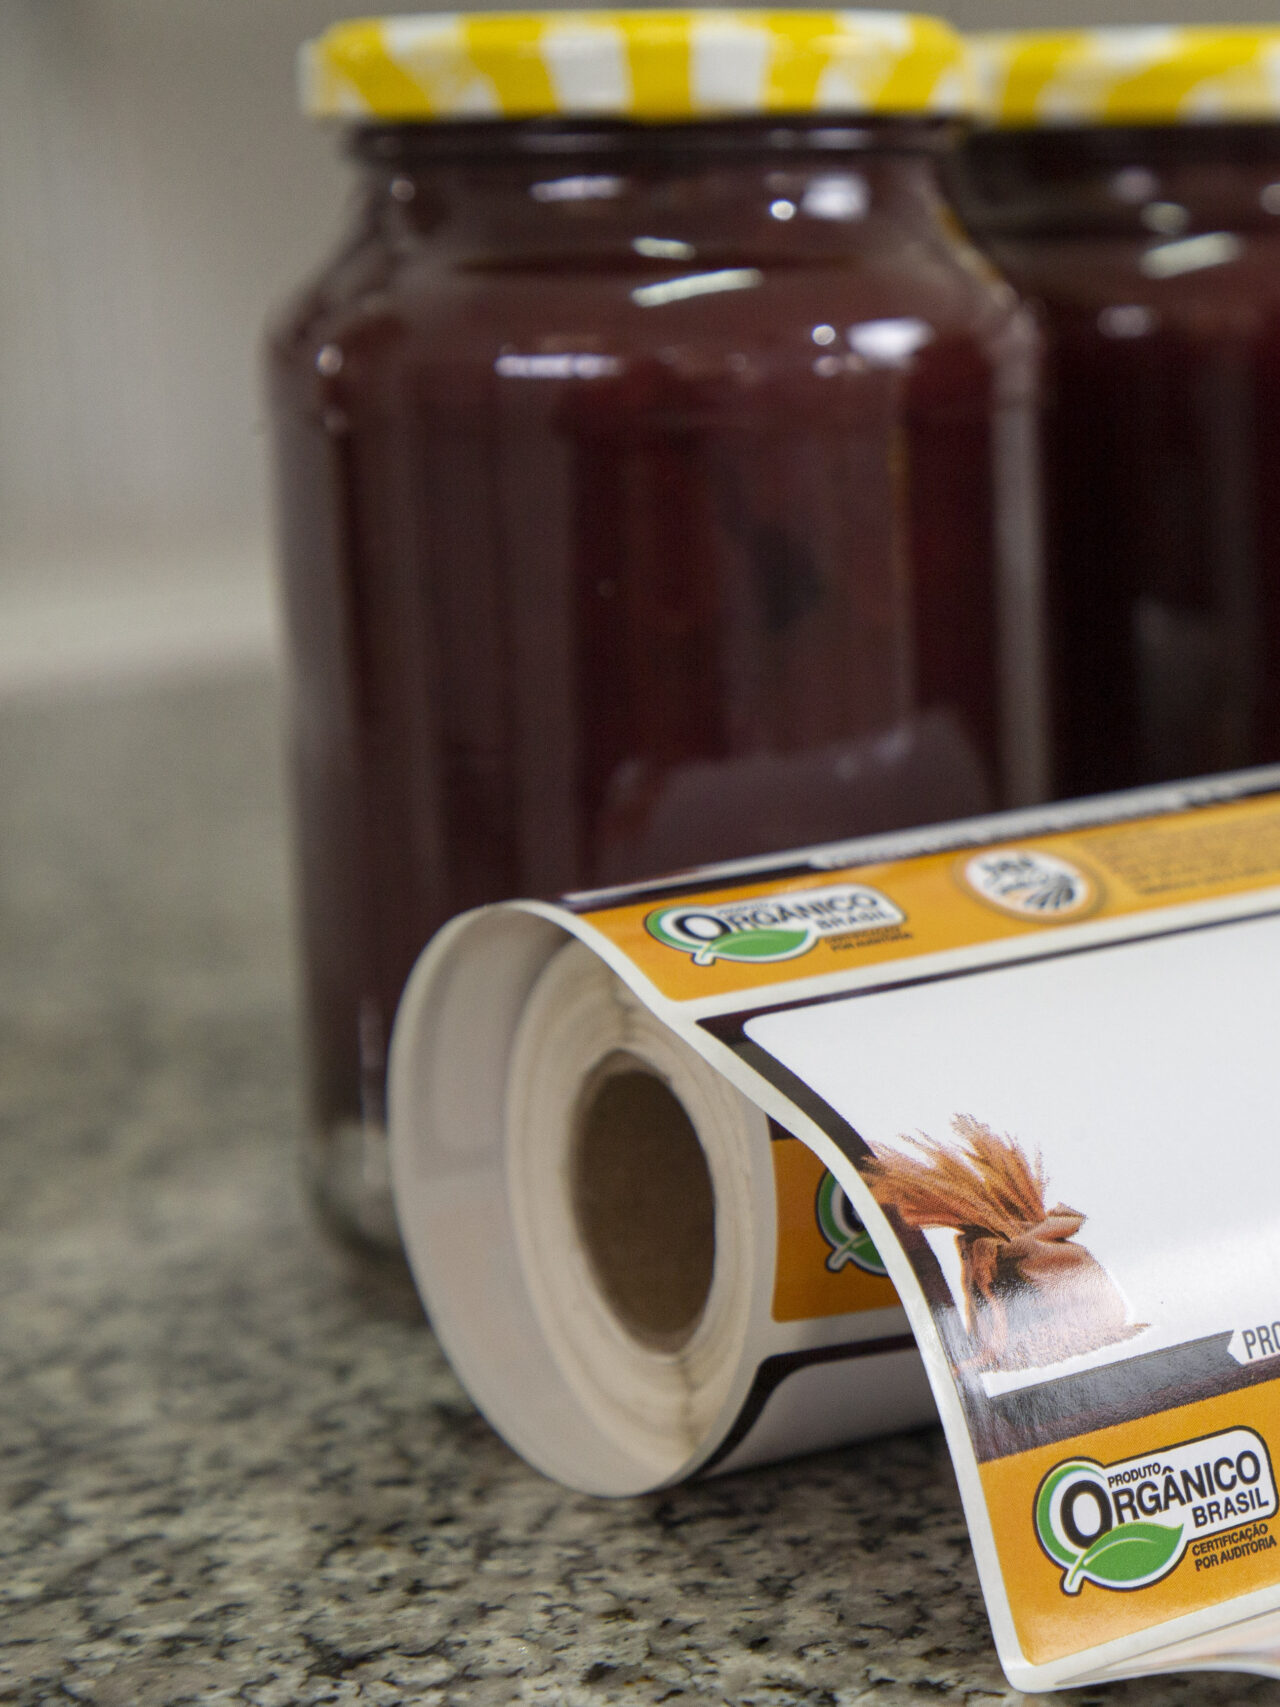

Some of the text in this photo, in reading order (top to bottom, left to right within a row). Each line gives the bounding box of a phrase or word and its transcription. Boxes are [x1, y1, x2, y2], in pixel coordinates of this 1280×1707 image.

[1107, 1462, 1162, 1488] PRODUTO
[1059, 1449, 1262, 1551] ORGÂNICO
[1191, 1486, 1270, 1529] BRASIL
[1191, 1523, 1269, 1557] CERTIFICAÇÃO
[1194, 1534, 1278, 1572] POR AUDITORIA
